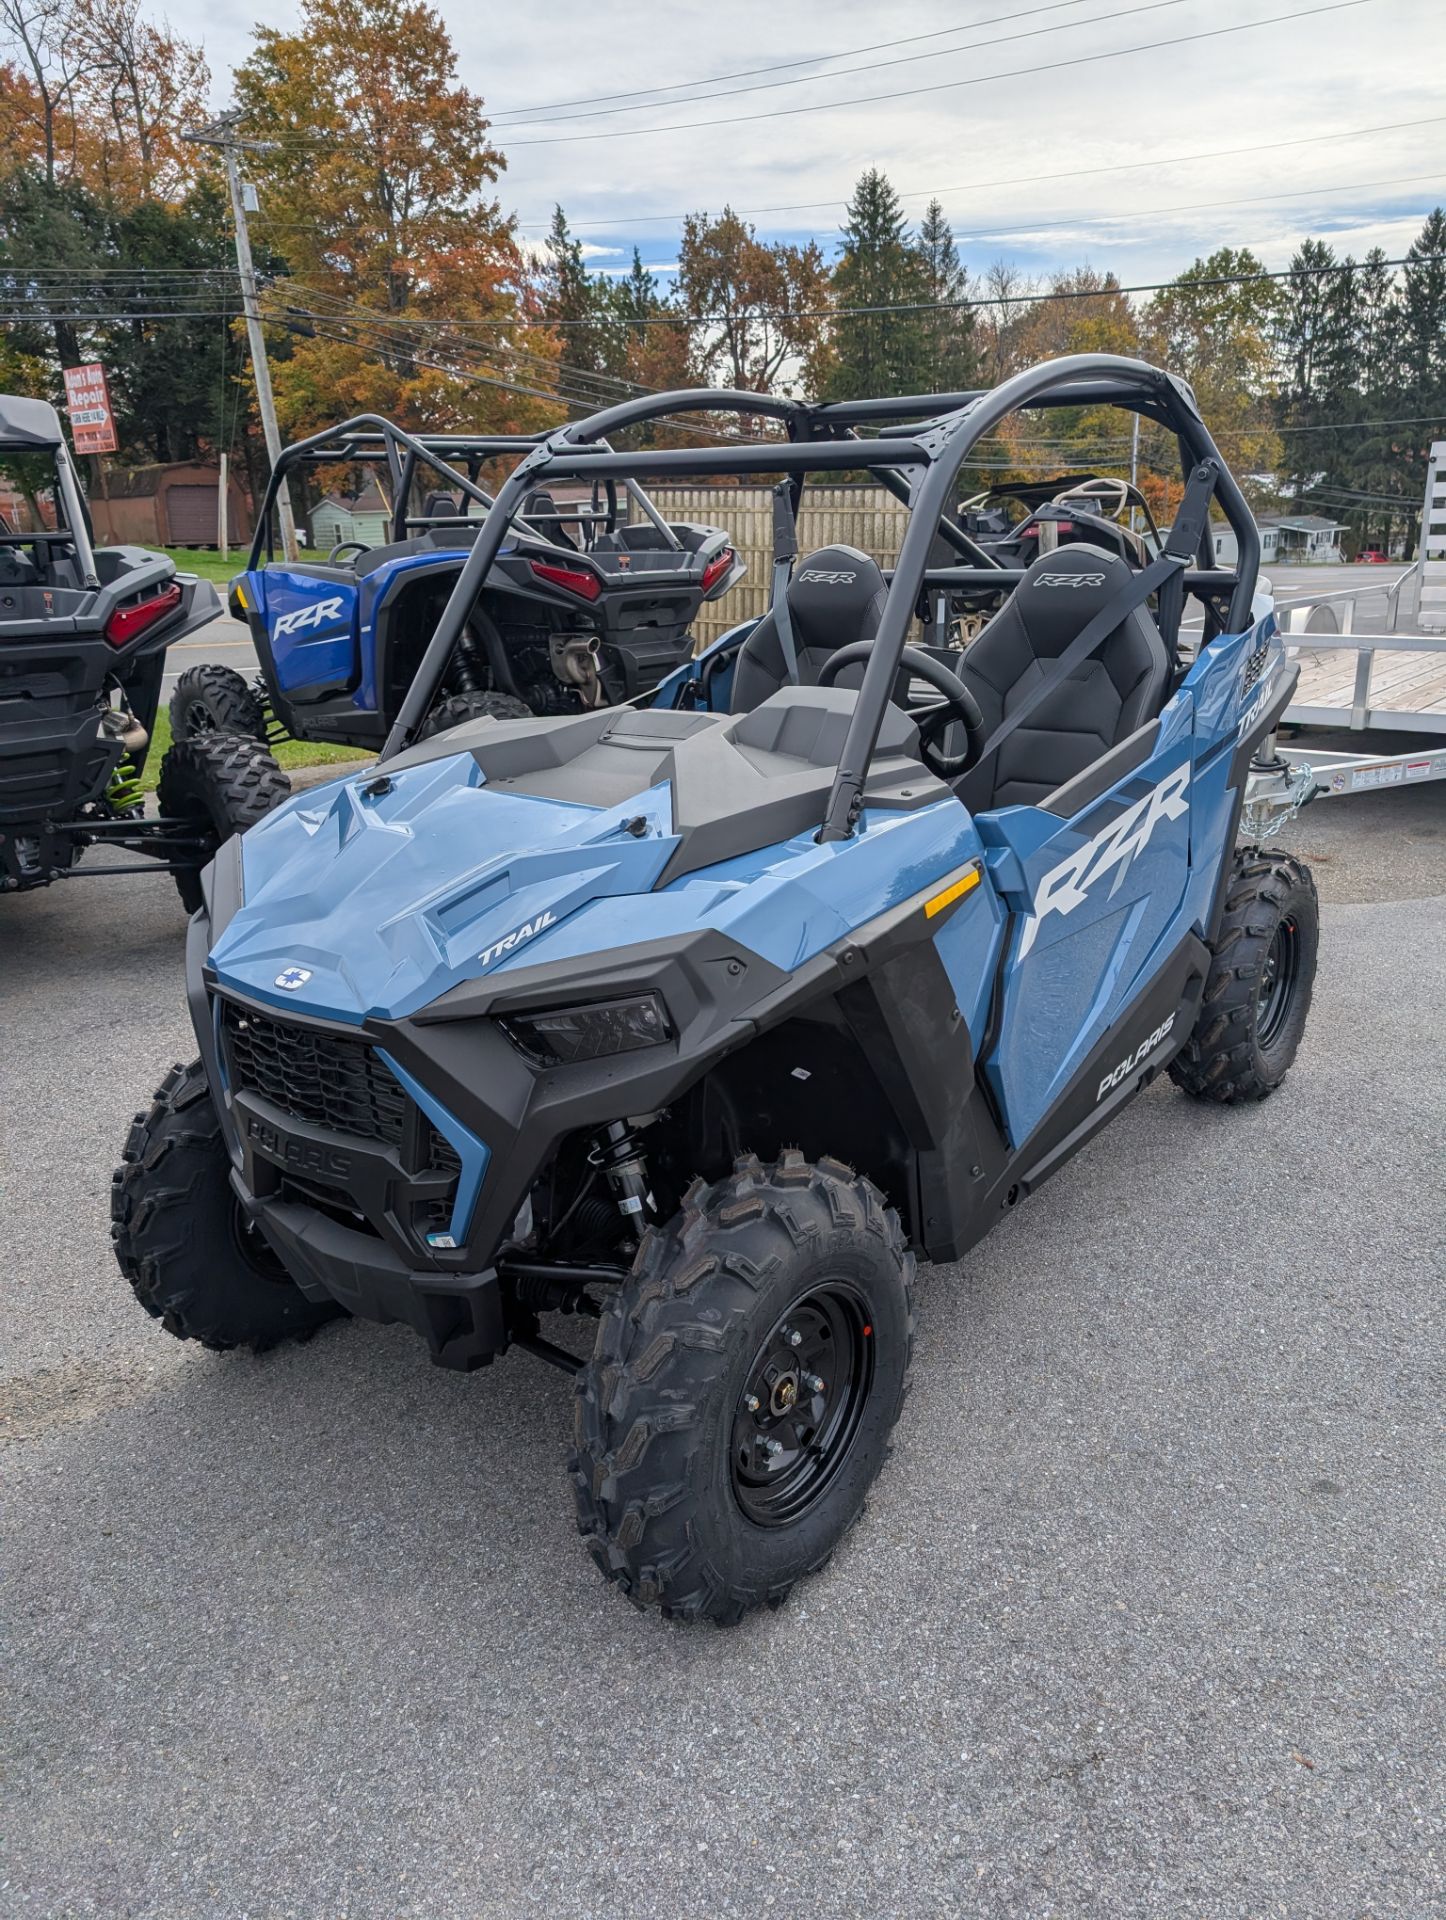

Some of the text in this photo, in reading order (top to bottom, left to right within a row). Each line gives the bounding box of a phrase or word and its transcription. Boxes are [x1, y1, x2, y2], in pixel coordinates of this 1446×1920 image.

[69, 386, 104, 408] Repair
[799, 569, 857, 584] RZR
[1033, 573, 1106, 588] RZR
[273, 596, 344, 641] RZR
[1237, 679, 1273, 738] TRAIL
[1018, 760, 1190, 963] RZR
[478, 911, 557, 966] TRAIL
[1096, 1011, 1176, 1102] POLARIS
[248, 1117, 351, 1180] POLARIS
